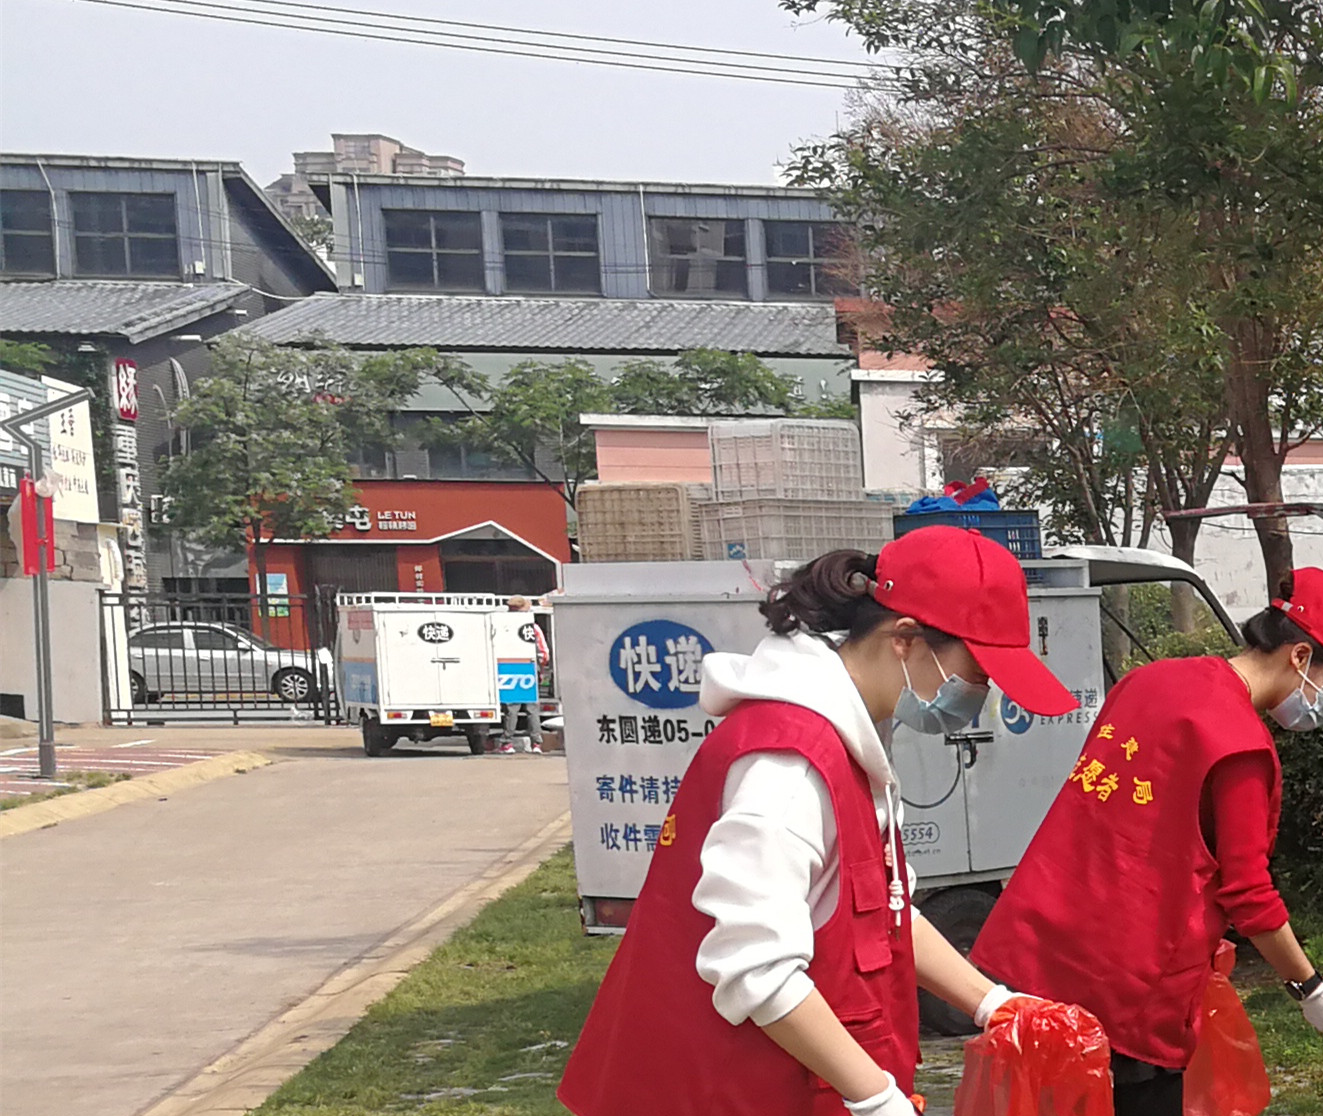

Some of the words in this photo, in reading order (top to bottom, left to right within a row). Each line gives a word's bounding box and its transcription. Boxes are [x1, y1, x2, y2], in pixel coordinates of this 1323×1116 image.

[377, 510, 392, 520] LE
[393, 510, 416, 520] TUN
[422, 624, 450, 641] 快递
[619, 634, 703, 695] 快递
[498, 673, 535, 690] ZTO
